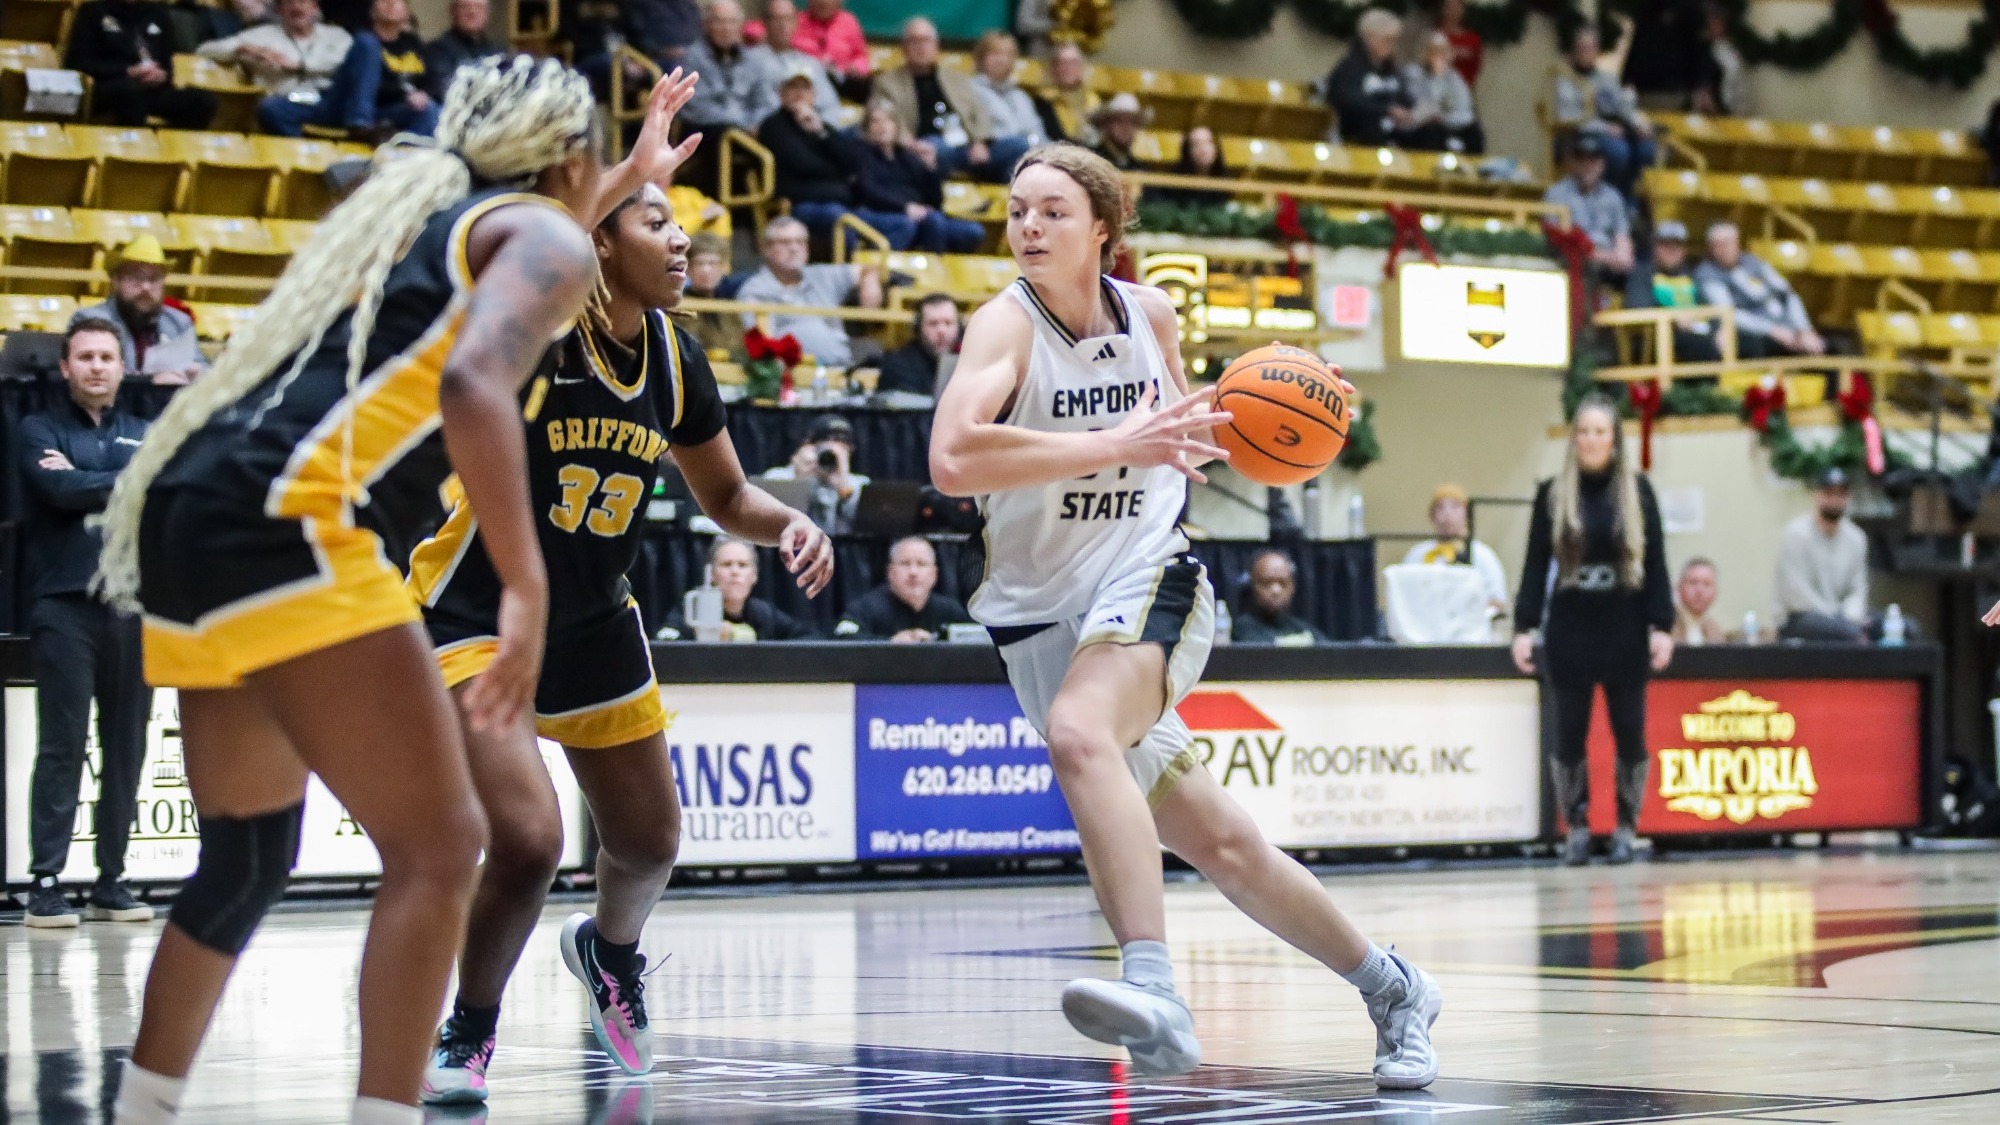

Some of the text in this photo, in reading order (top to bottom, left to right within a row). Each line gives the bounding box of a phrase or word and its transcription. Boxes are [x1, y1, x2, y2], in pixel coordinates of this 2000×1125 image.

[1261, 366, 1343, 421] Wilson
[547, 417, 669, 464] GRIFFON
[548, 463, 645, 538] 33
[1060, 490, 1145, 521] STATE
[869, 717, 1007, 757] Remington
[1194, 735, 1286, 788] RAY
[670, 743, 813, 807] ANSAS
[902, 764, 1053, 796] 620.268.0549
[1658, 745, 1819, 798] EMPORIA
[680, 810, 814, 842] urance
